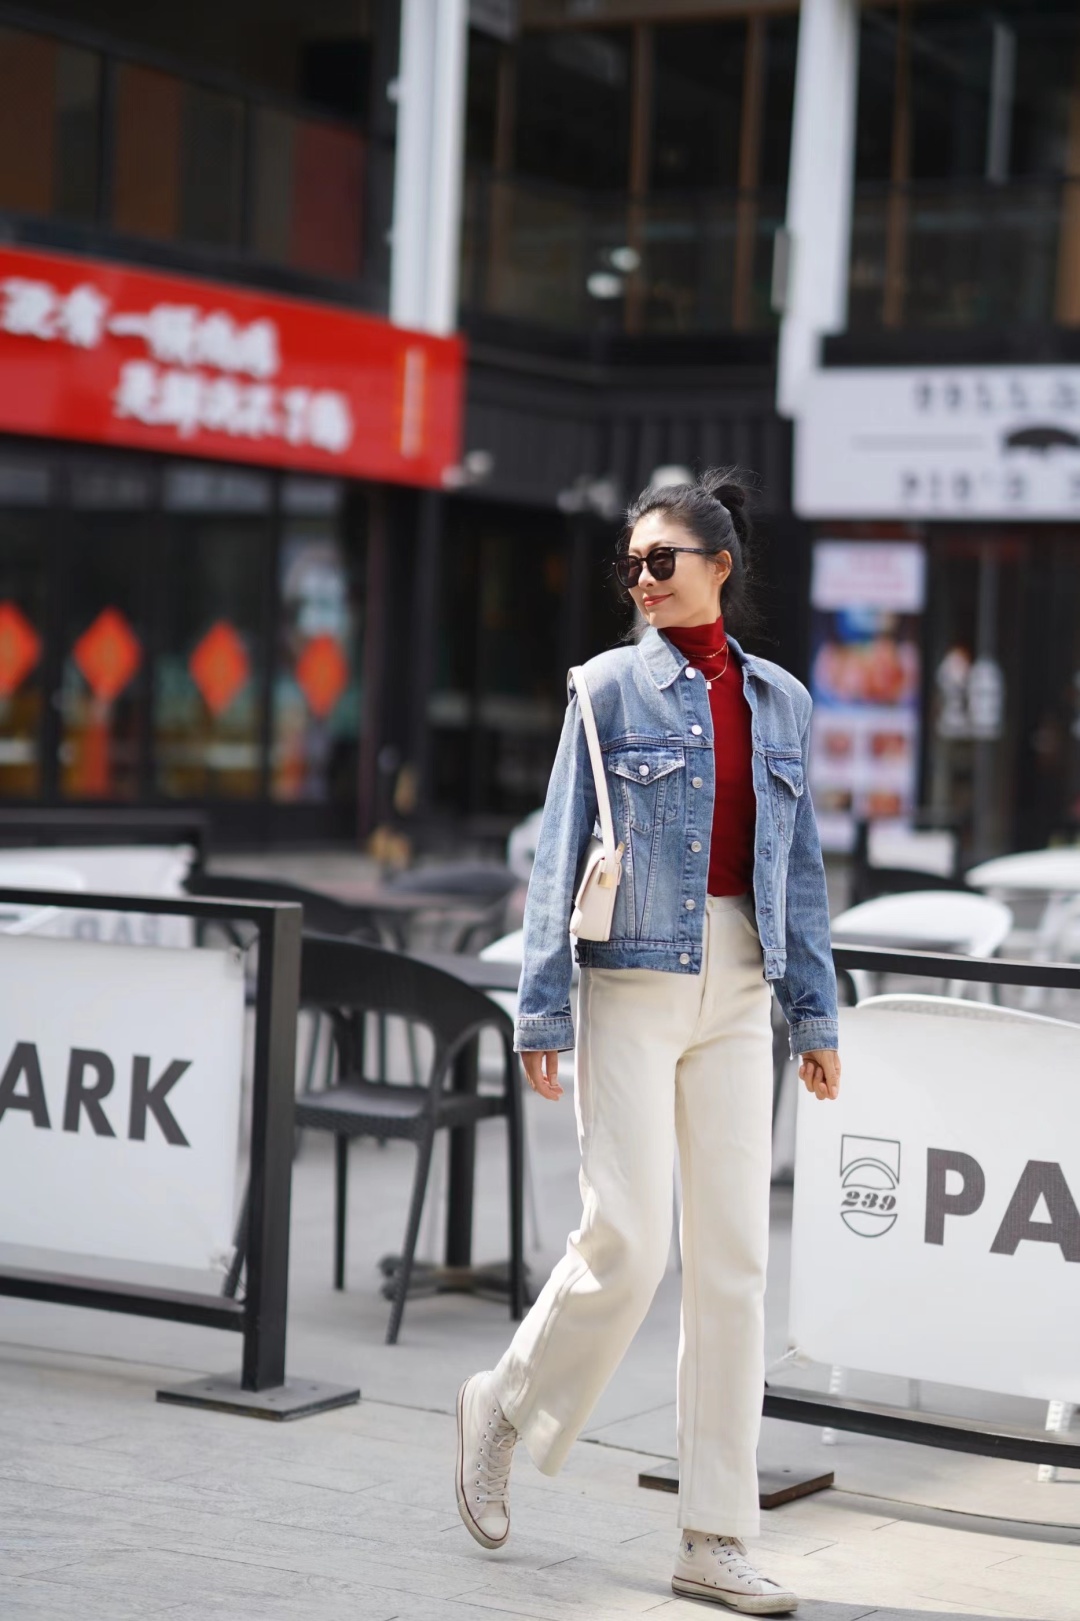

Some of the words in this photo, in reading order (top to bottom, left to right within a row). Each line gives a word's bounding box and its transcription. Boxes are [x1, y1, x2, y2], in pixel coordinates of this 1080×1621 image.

[0, 1040, 193, 1148] ARK
[841, 1190, 897, 1212] 239
[924, 1147, 1080, 1263] PA
